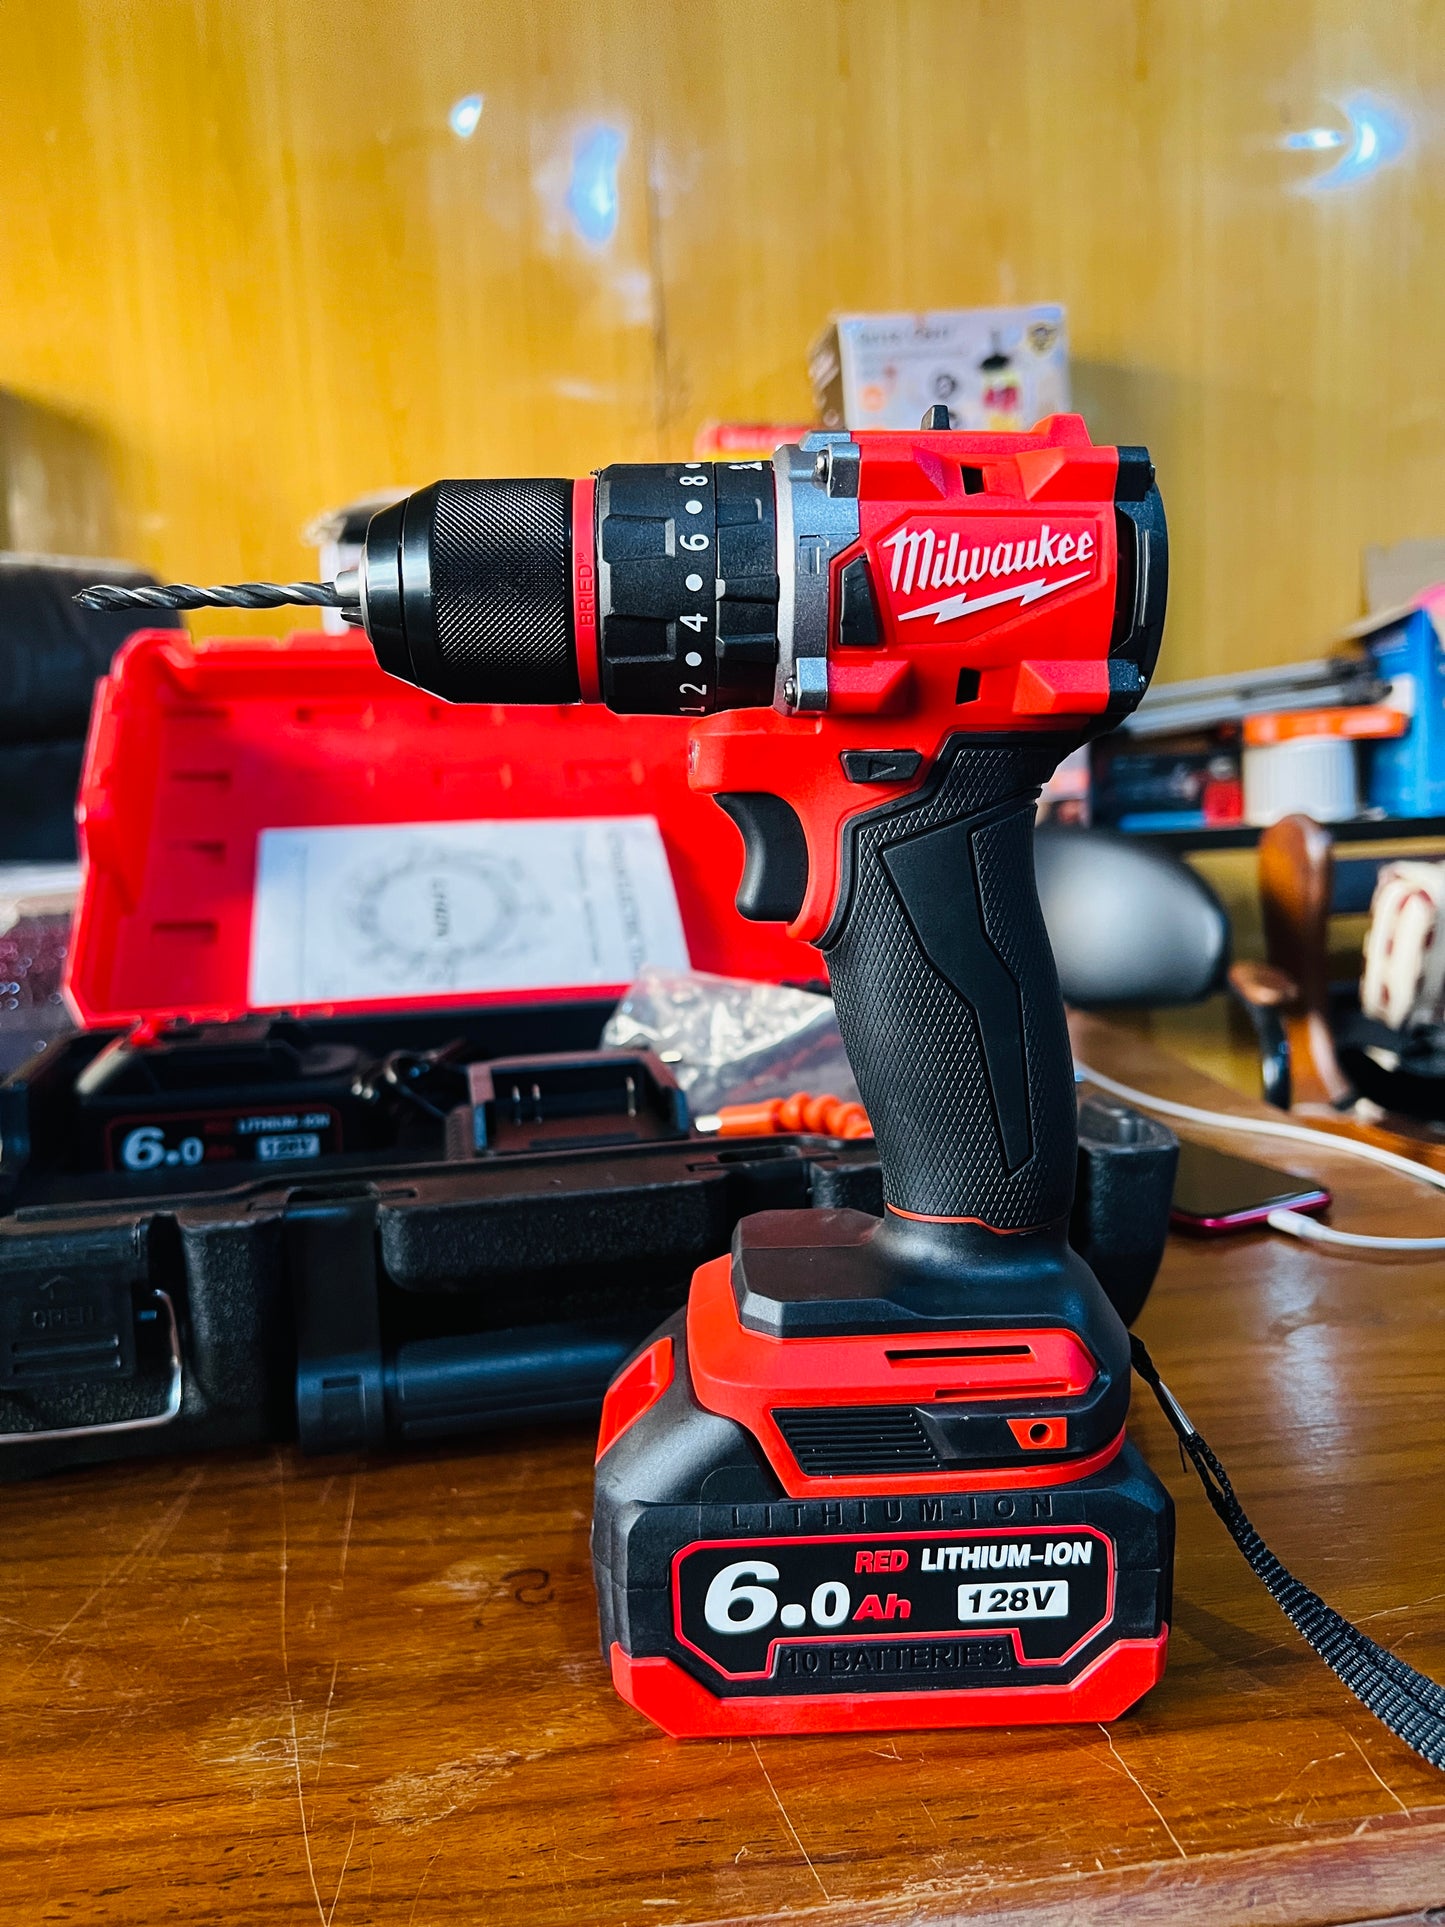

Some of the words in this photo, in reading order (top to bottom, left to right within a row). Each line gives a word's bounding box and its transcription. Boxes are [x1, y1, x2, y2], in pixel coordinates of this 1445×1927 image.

[679, 475, 709, 487] 8
[679, 533, 710, 552] 6
[882, 524, 1094, 596] Milwaukee
[679, 613, 708, 633] 4
[679, 683, 707, 696] 2
[122, 1126, 204, 1171] 6.0
[732, 1494, 1054, 1530] LITHIUM-ION
[855, 1550, 909, 1574] RED
[921, 1541, 1092, 1572] LITHIUM-ION
[704, 1560, 850, 1634] 6.0
[852, 1594, 912, 1620] Ah
[968, 1586, 1056, 1613] 128V
[830, 1644, 1005, 1671] BATTERIES
